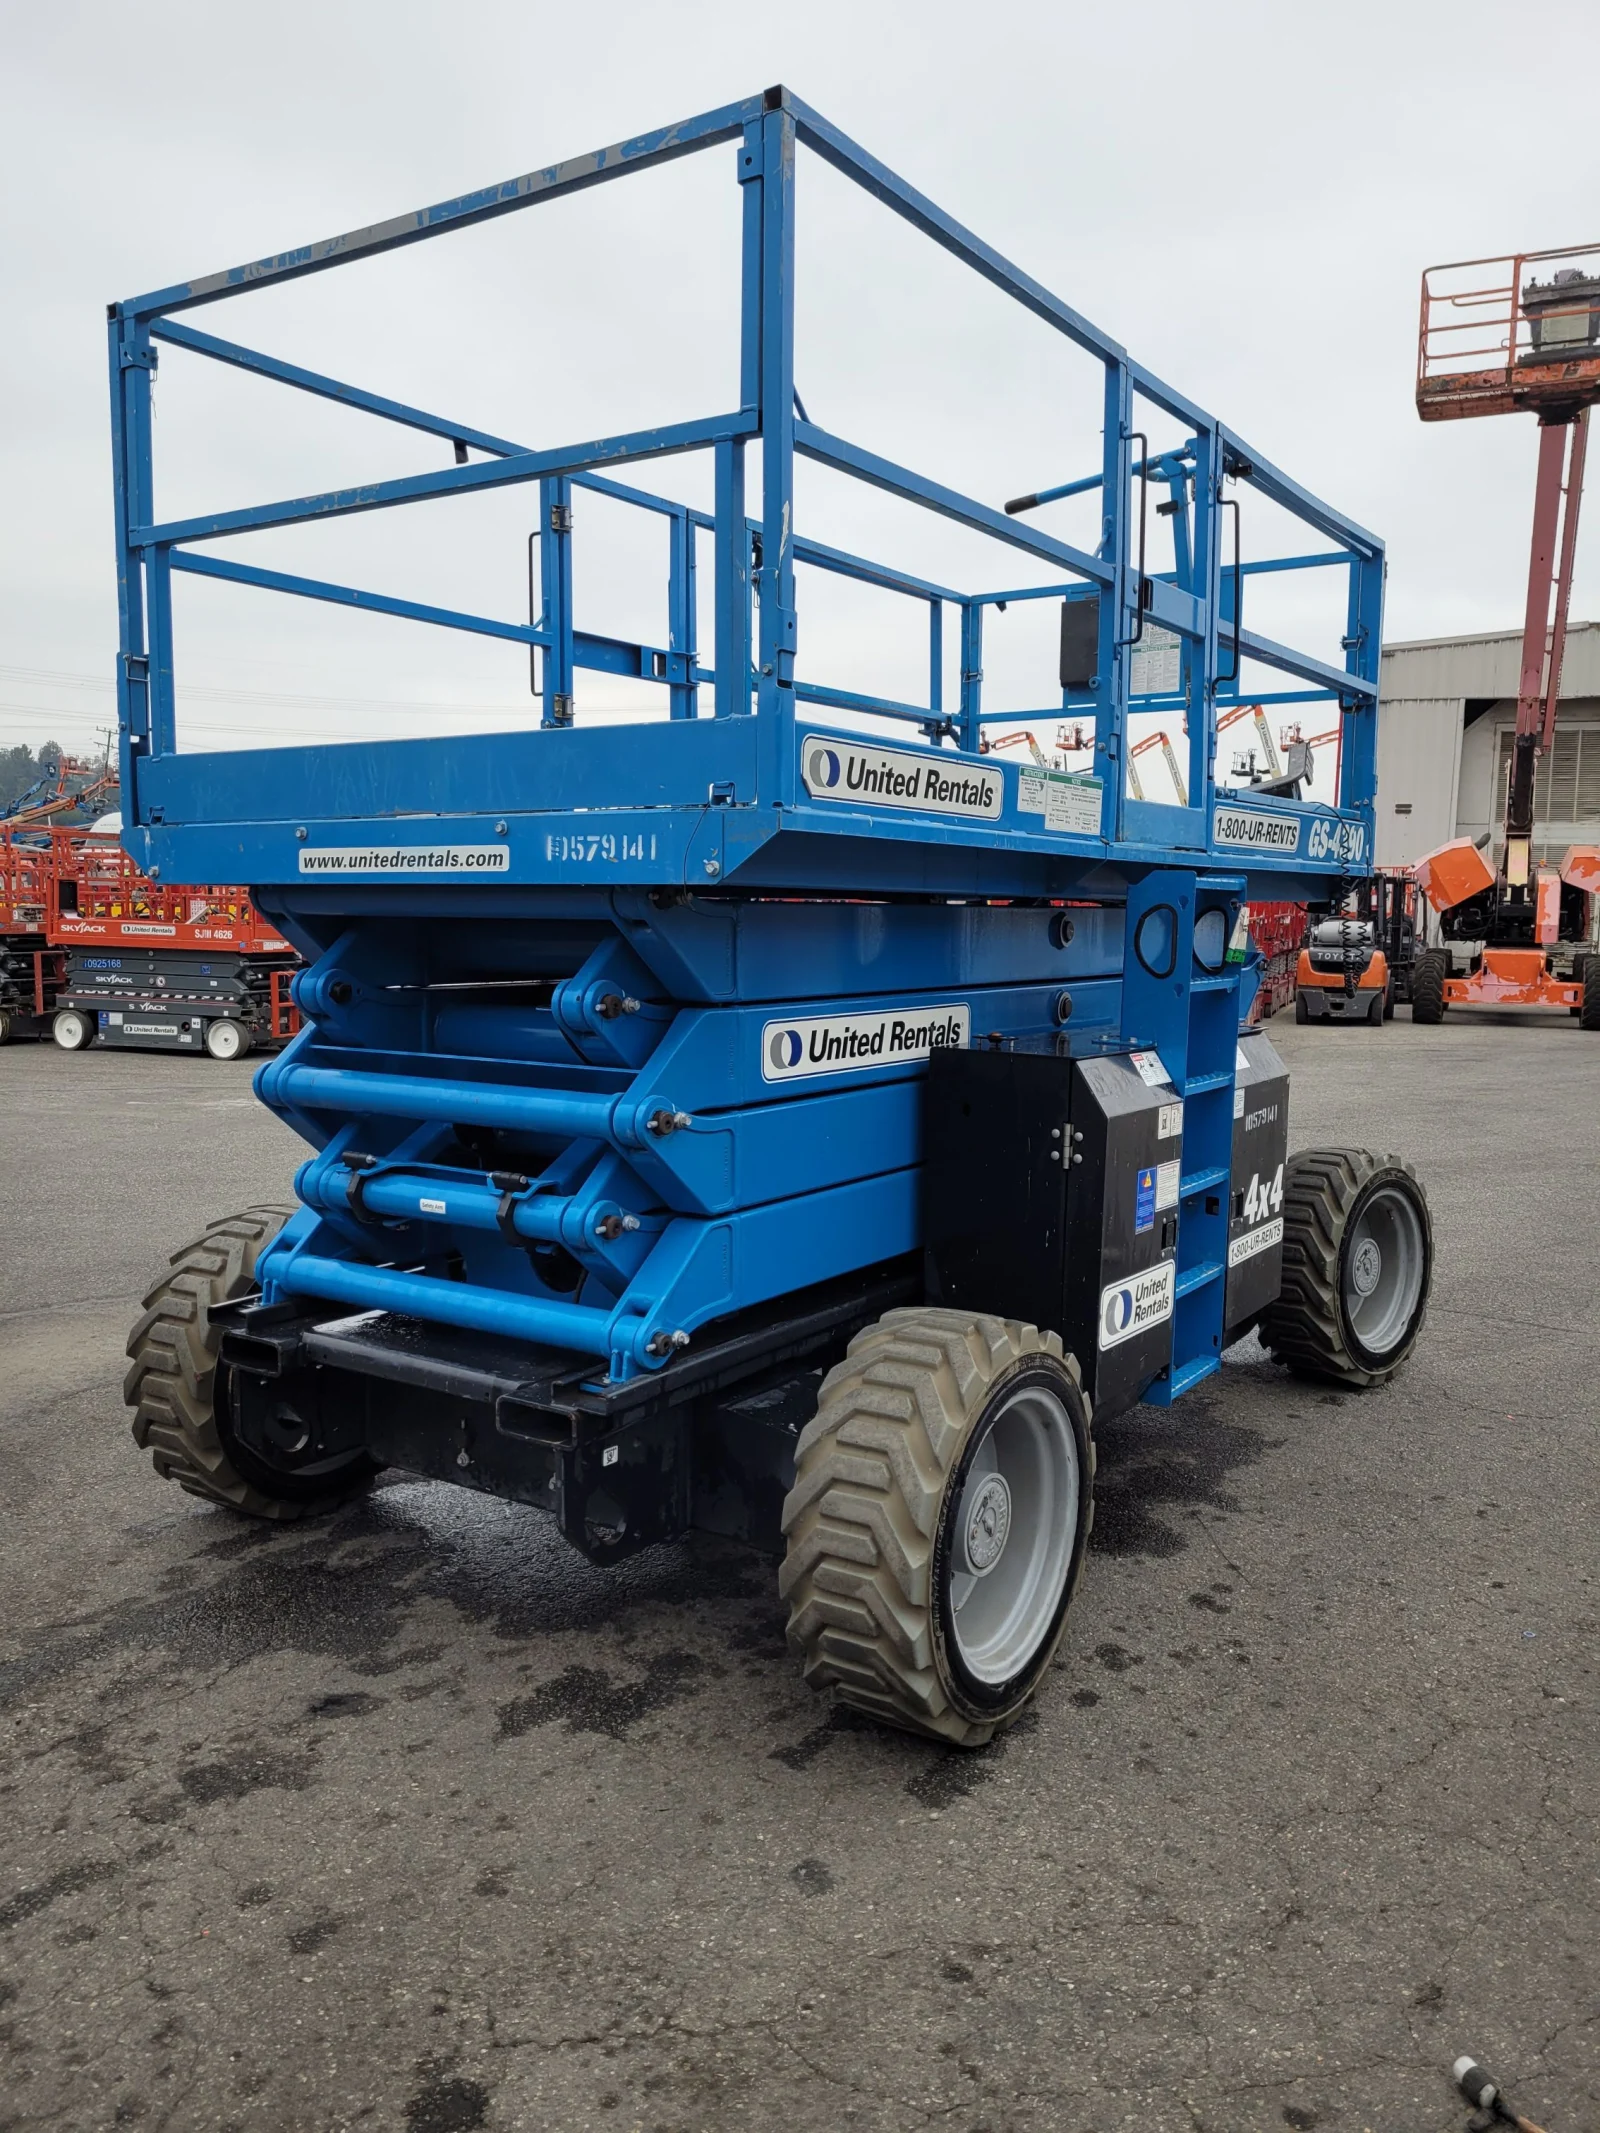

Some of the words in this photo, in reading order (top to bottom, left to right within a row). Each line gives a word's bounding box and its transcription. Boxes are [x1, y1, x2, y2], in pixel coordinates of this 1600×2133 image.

[845, 755, 922, 799] United
[923, 767, 994, 808] Rentals
[1217, 815, 1298, 846] 1-800-UR-RENTS
[1308, 819, 1365, 862] GS-4390
[303, 849, 504, 870] www.unitedrentals.com
[60, 921, 107, 934] SKYJACK
[213, 930, 233, 940] 4626
[1317, 952, 1361, 960] TOYT
[95, 974, 134, 984] SKYJACK
[808, 1022, 886, 1063] United
[889, 1015, 962, 1053] Rentals
[1243, 1163, 1284, 1225] 4x4
[1231, 1223, 1282, 1262] 1-800-UR-RENTS
[1135, 1271, 1168, 1303] United
[1133, 1293, 1170, 1325] Rentals
